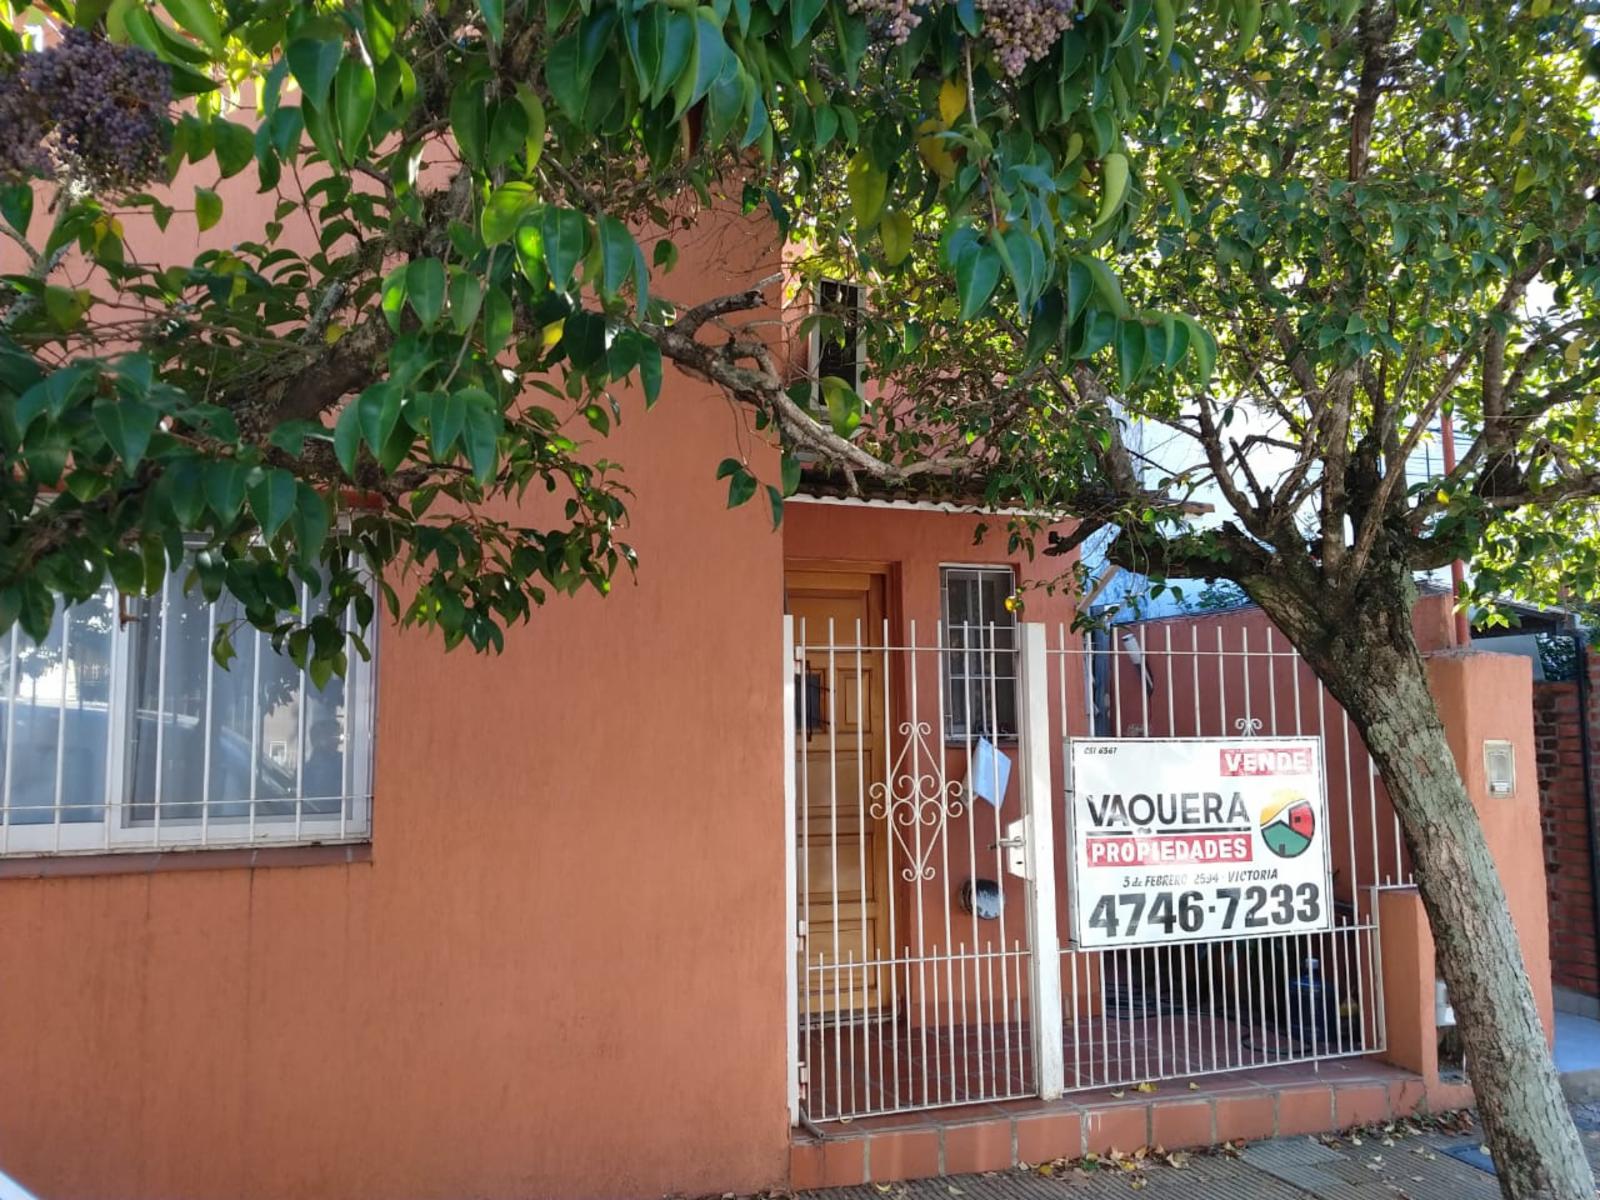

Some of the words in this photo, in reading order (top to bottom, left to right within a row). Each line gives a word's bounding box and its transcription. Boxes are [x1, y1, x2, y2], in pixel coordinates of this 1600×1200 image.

[1224, 751, 1308, 772] VENDE
[1091, 838, 1247, 863] PROPIEDADES
[1144, 873, 1188, 887] FEBRERO
[1227, 868, 1279, 883] VICTORIA
